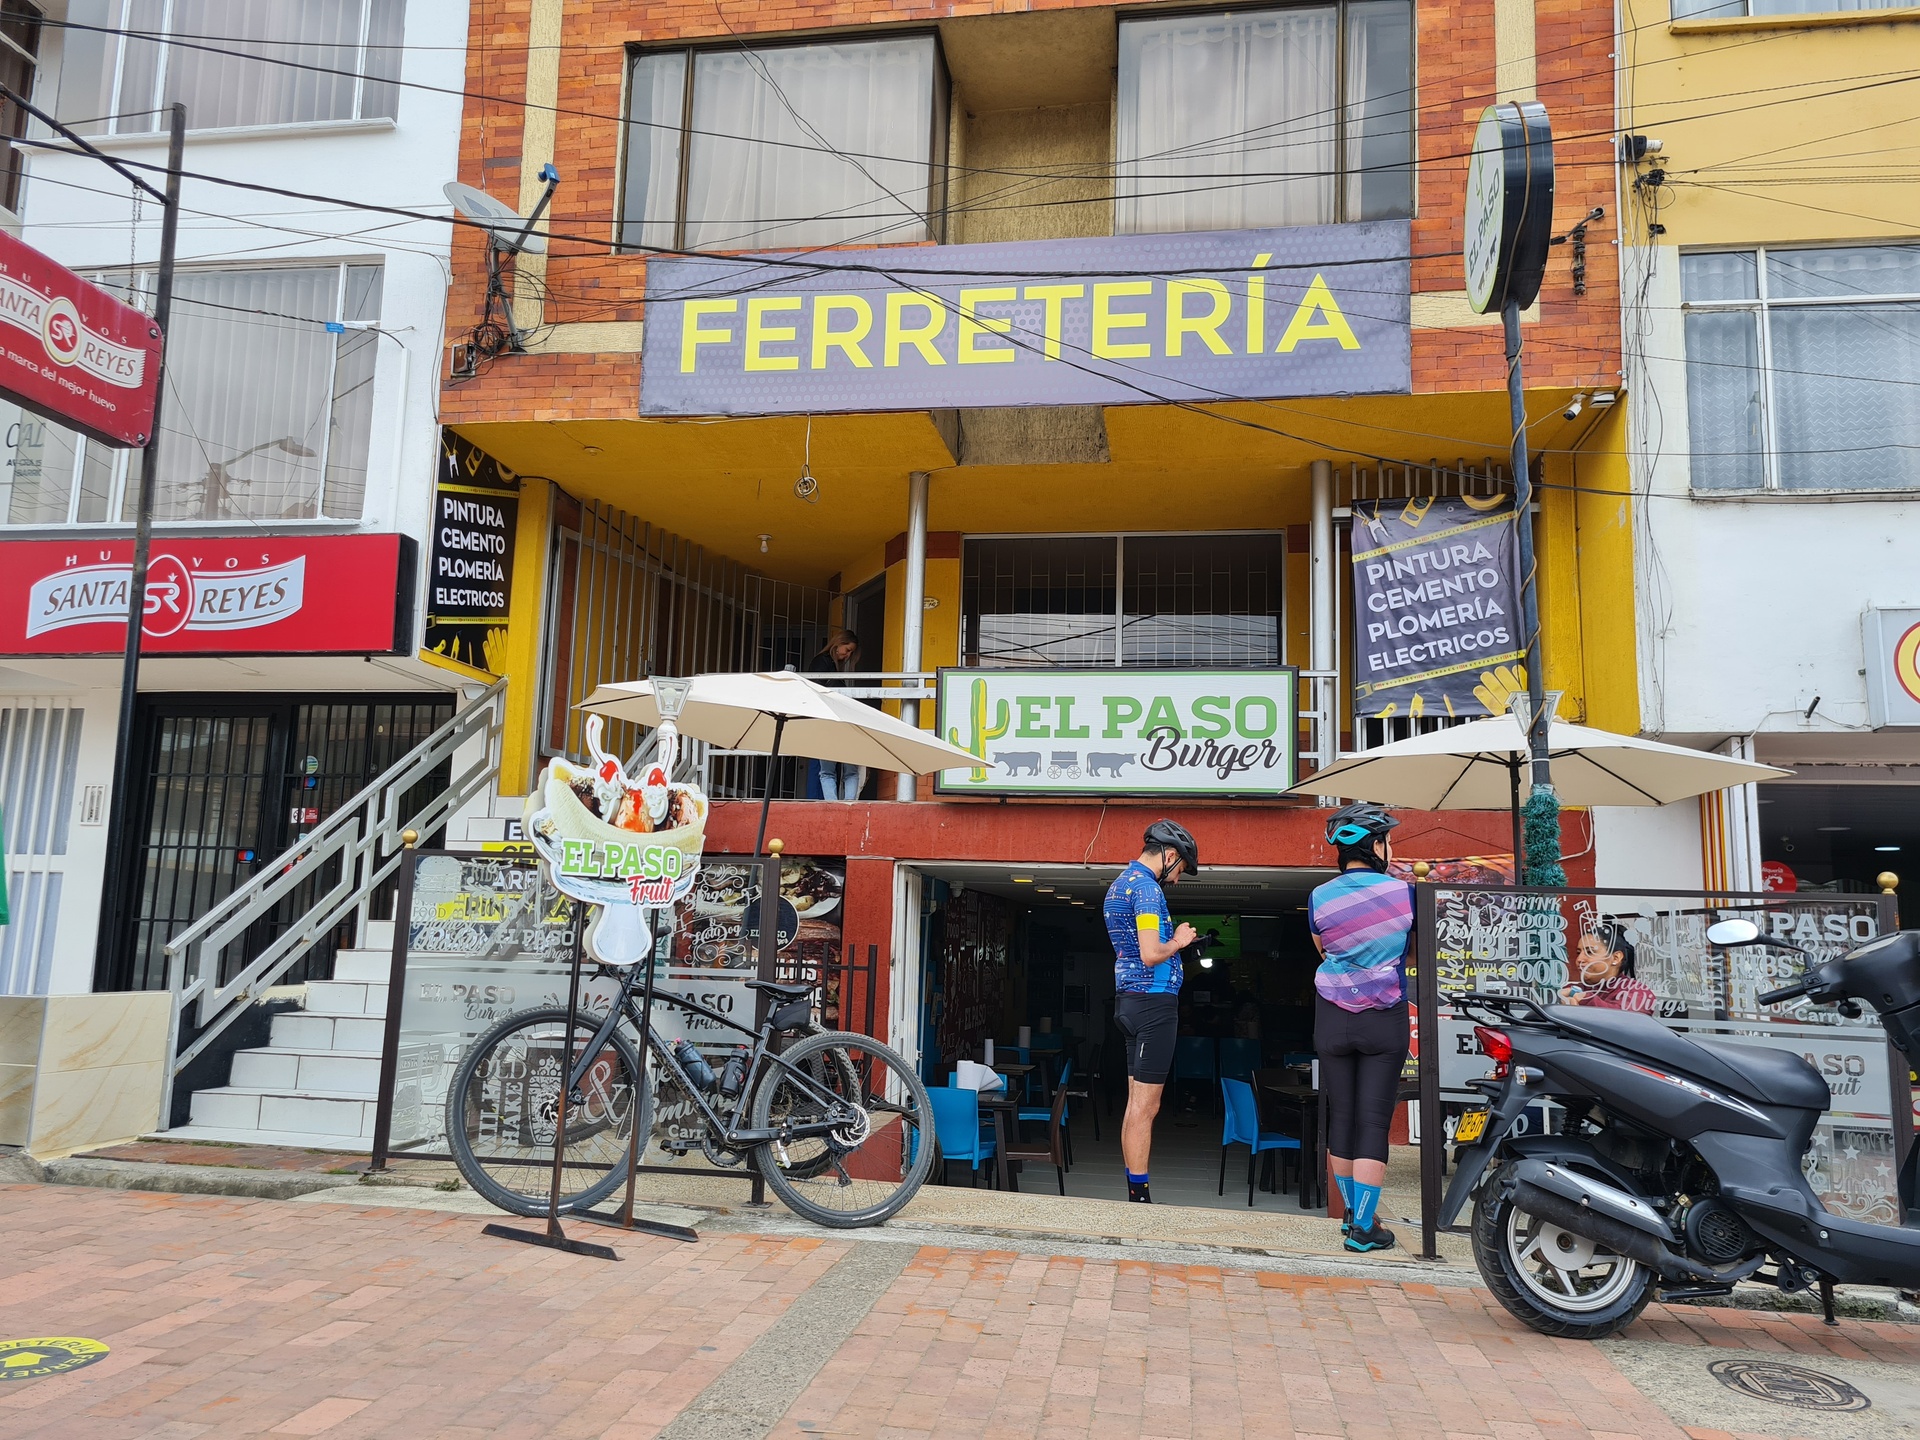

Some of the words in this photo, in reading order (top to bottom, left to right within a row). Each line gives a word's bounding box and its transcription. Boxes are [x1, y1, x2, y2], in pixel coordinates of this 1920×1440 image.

[679, 252, 1361, 373] FERRETERÍA
[0, 287, 40, 325] ANTA
[83, 342, 136, 377] REYES
[7, 349, 39, 373] marca
[41, 365, 56, 381] del
[58, 376, 87, 396] mejor
[89, 389, 117, 412] huevo
[443, 497, 505, 529] PINTURA
[441, 527, 506, 555] CEMENTO
[65, 550, 270, 568] HUVOS
[438, 556, 505, 582] PLOMERÍA
[1365, 541, 1494, 586] PINTURA
[44, 580, 128, 616] SANTA
[199, 576, 289, 614] REYES
[436, 587, 505, 608] ELECTRICOS
[1367, 568, 1499, 613] CEMENTO
[1367, 596, 1505, 643] PLOMERÍA
[1368, 627, 1510, 672] ELECTRICOS
[1014, 695, 1090, 739] EL
[1101, 695, 1278, 740] PASO
[1140, 725, 1282, 780] Burger
[561, 840, 600, 875] EL
[603, 843, 682, 879] PASO
[627, 875, 674, 903] Fruit
[1501, 912, 1569, 930] GOOD
[1769, 912, 1877, 943] PASO
[522, 929, 575, 946] PASO
[1471, 928, 1570, 963] BEER
[1501, 960, 1570, 986] GOOD
[1728, 953, 1794, 978] RIBS
[452, 984, 516, 1006] PASO
[1615, 991, 1689, 1017] Wings
[1794, 1009, 1846, 1026] Carry
[475, 1057, 528, 1080] OLD
[1803, 1052, 1865, 1077] ASO
[668, 1124, 707, 1139] Carr
